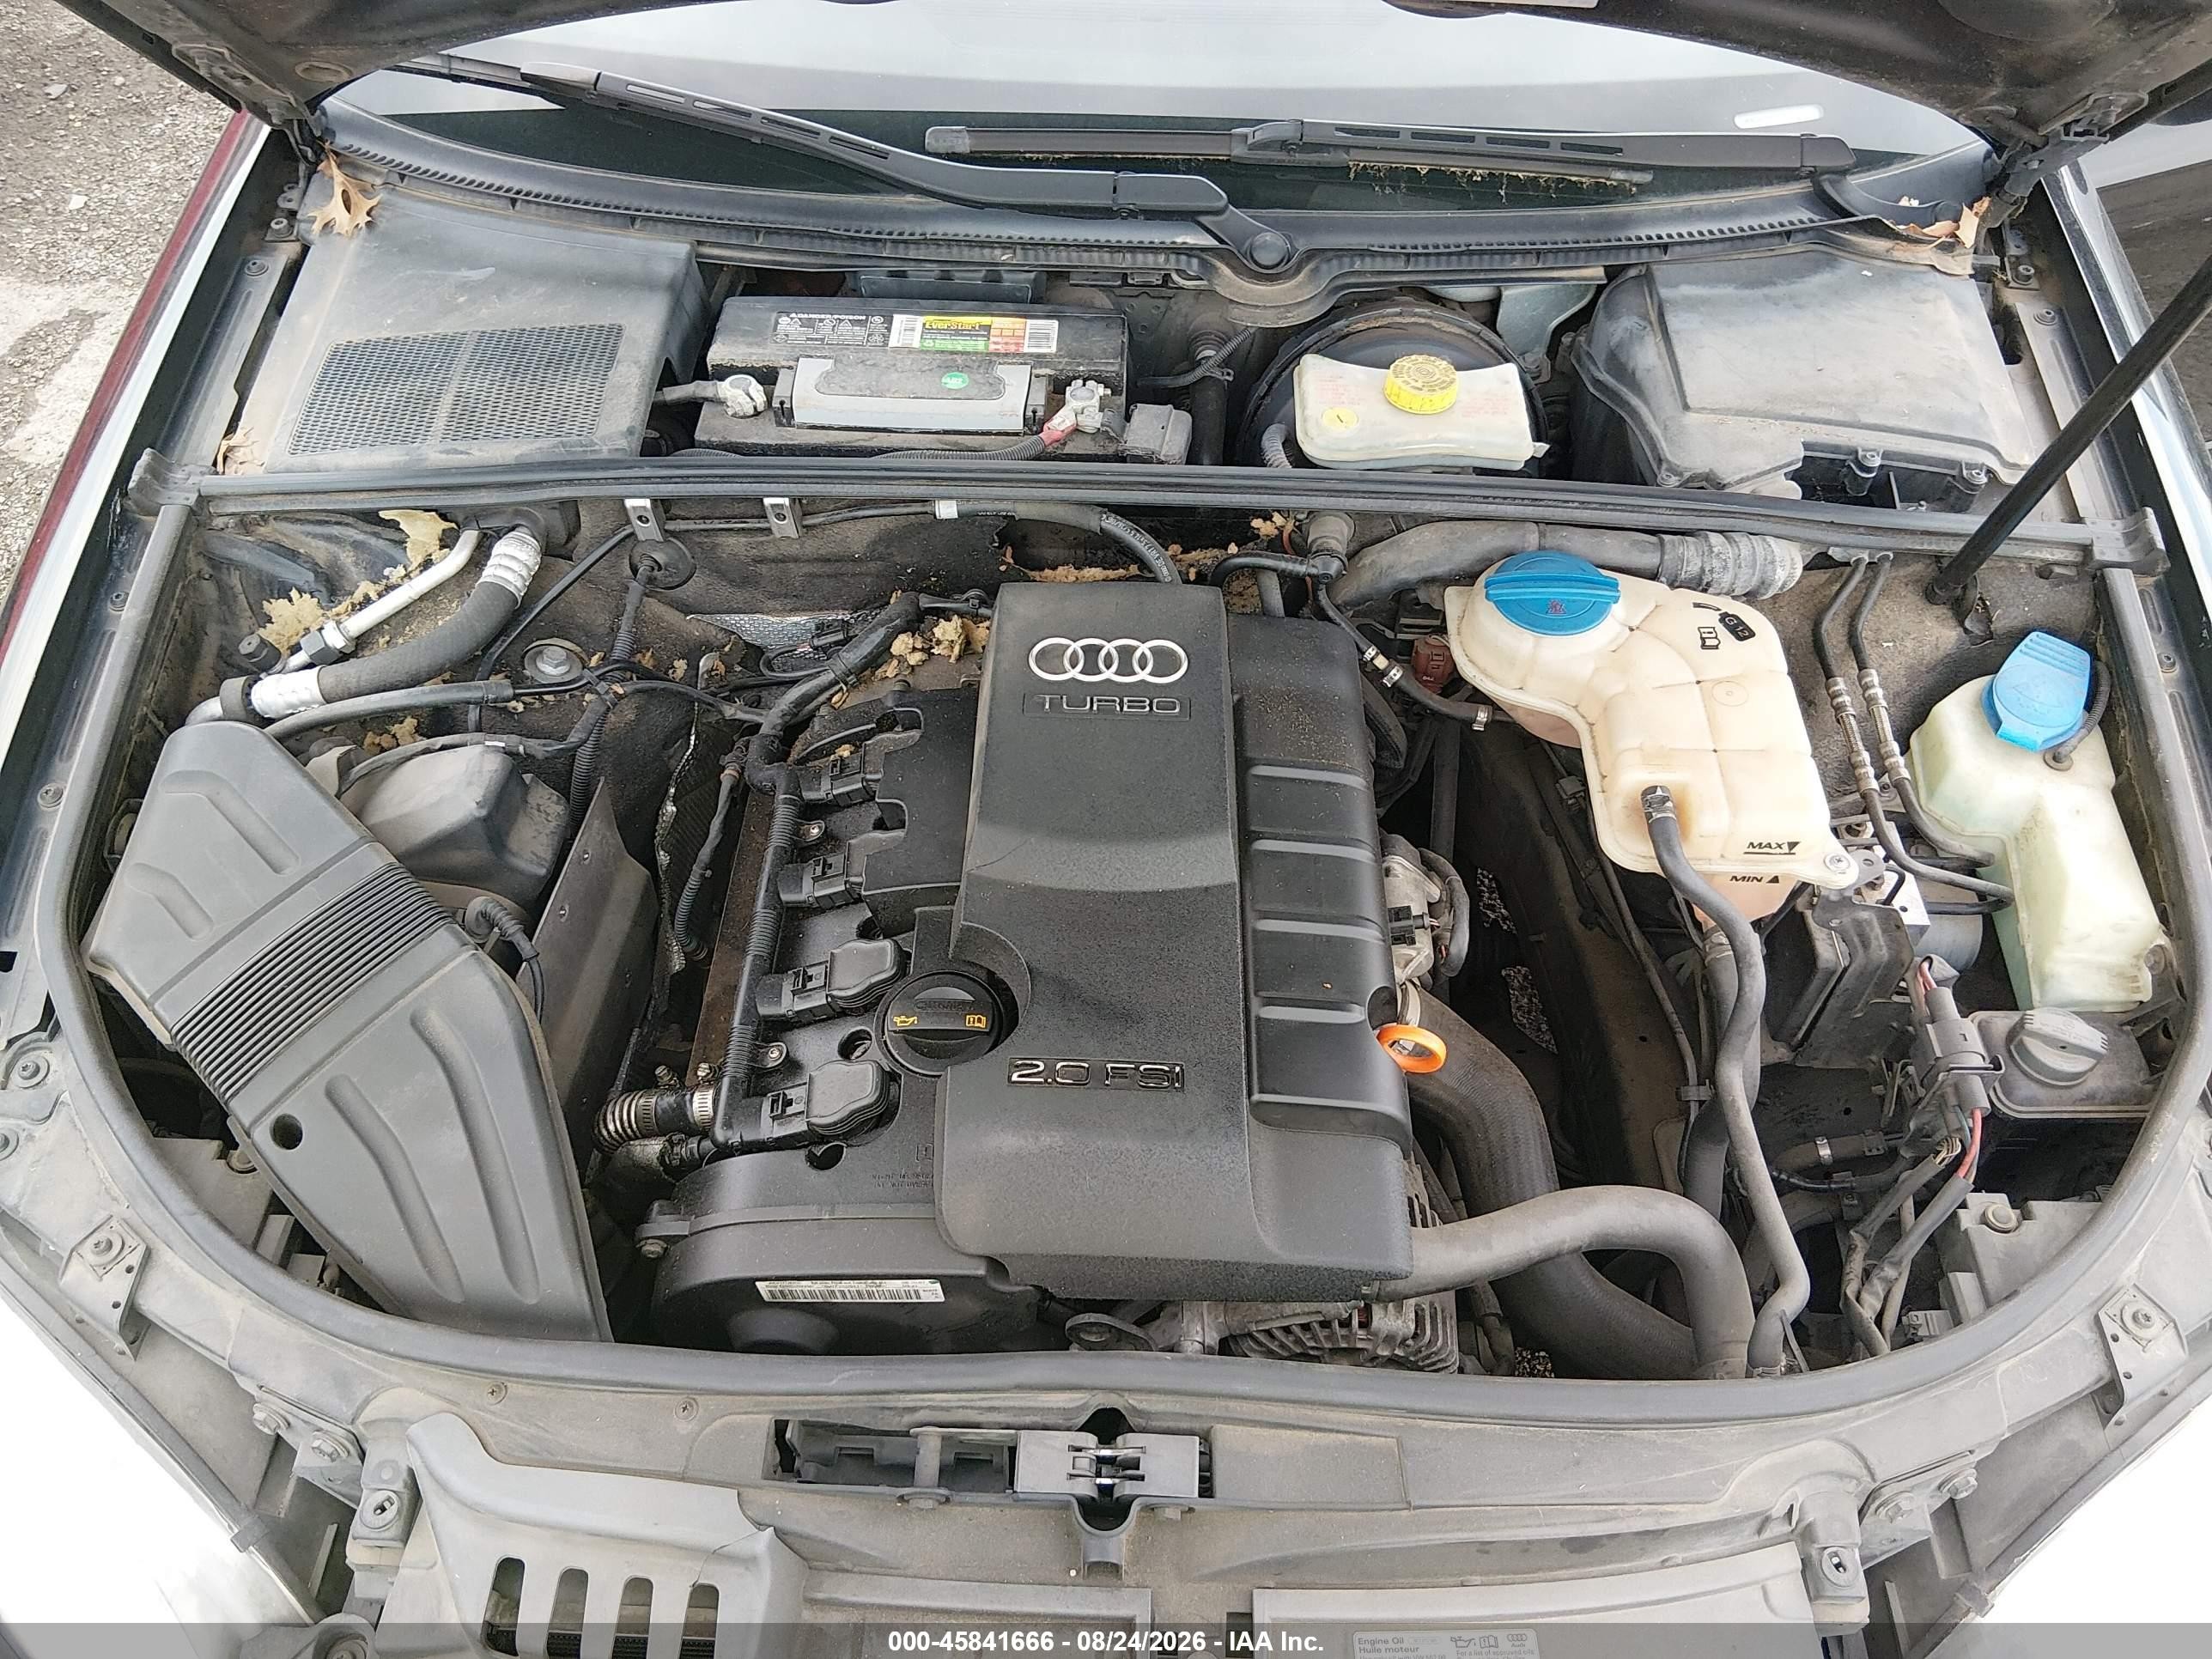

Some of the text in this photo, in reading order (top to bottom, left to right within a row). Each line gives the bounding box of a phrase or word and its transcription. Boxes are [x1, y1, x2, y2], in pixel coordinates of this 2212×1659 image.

[925, 321, 981, 331] EverStart
[1035, 694, 1182, 715] TURBO
[1747, 841, 1785, 850] MAX
[1011, 1060, 1182, 1090] 2.0 FSI
[1358, 1638, 1389, 1646] Engine
